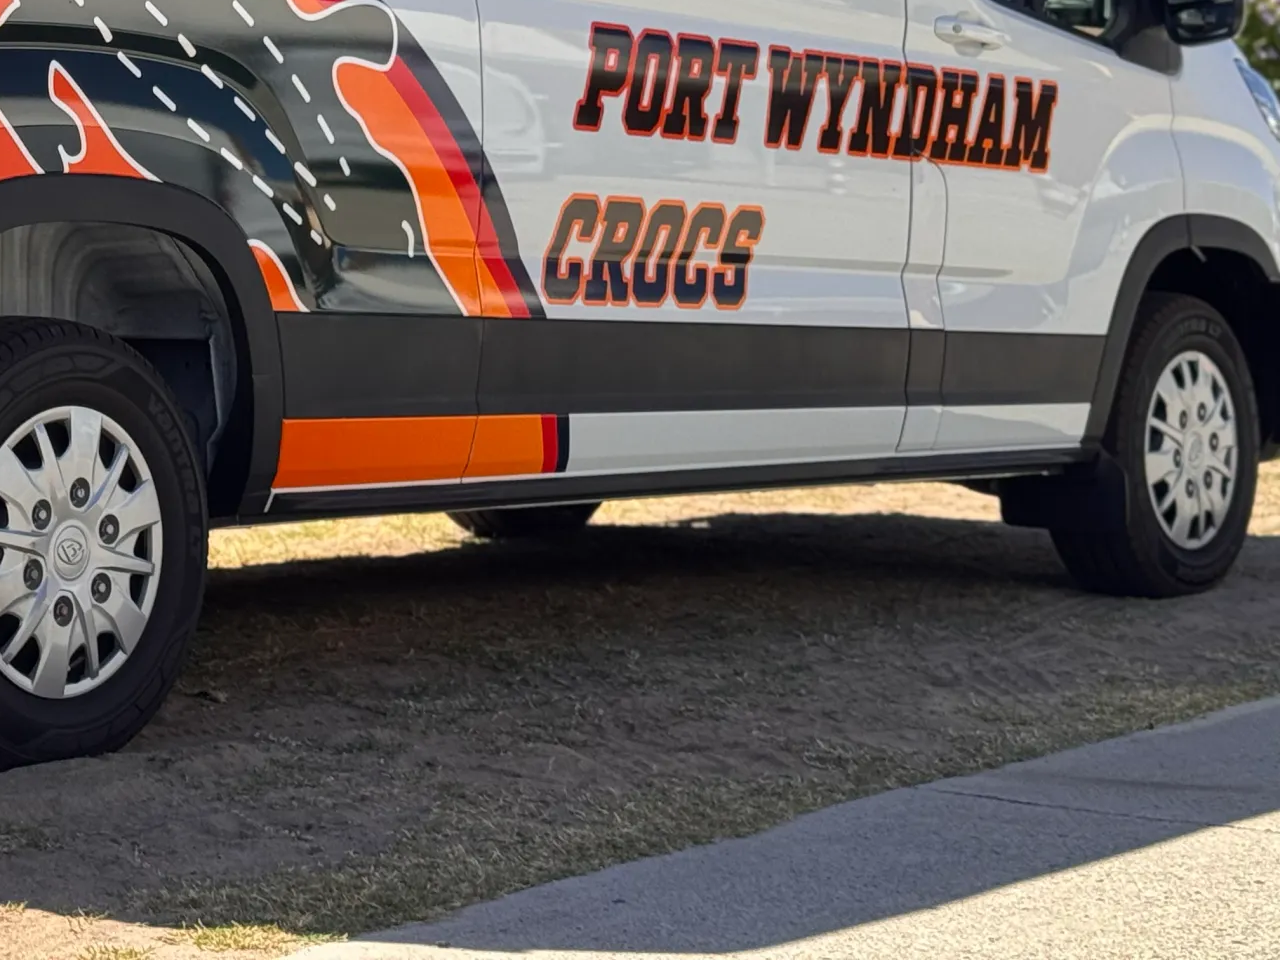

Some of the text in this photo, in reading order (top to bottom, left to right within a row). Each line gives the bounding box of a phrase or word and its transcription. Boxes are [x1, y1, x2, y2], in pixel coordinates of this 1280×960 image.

[572, 21, 1058, 174] PORT WYNDHAM
[541, 192, 766, 312] CROCS
